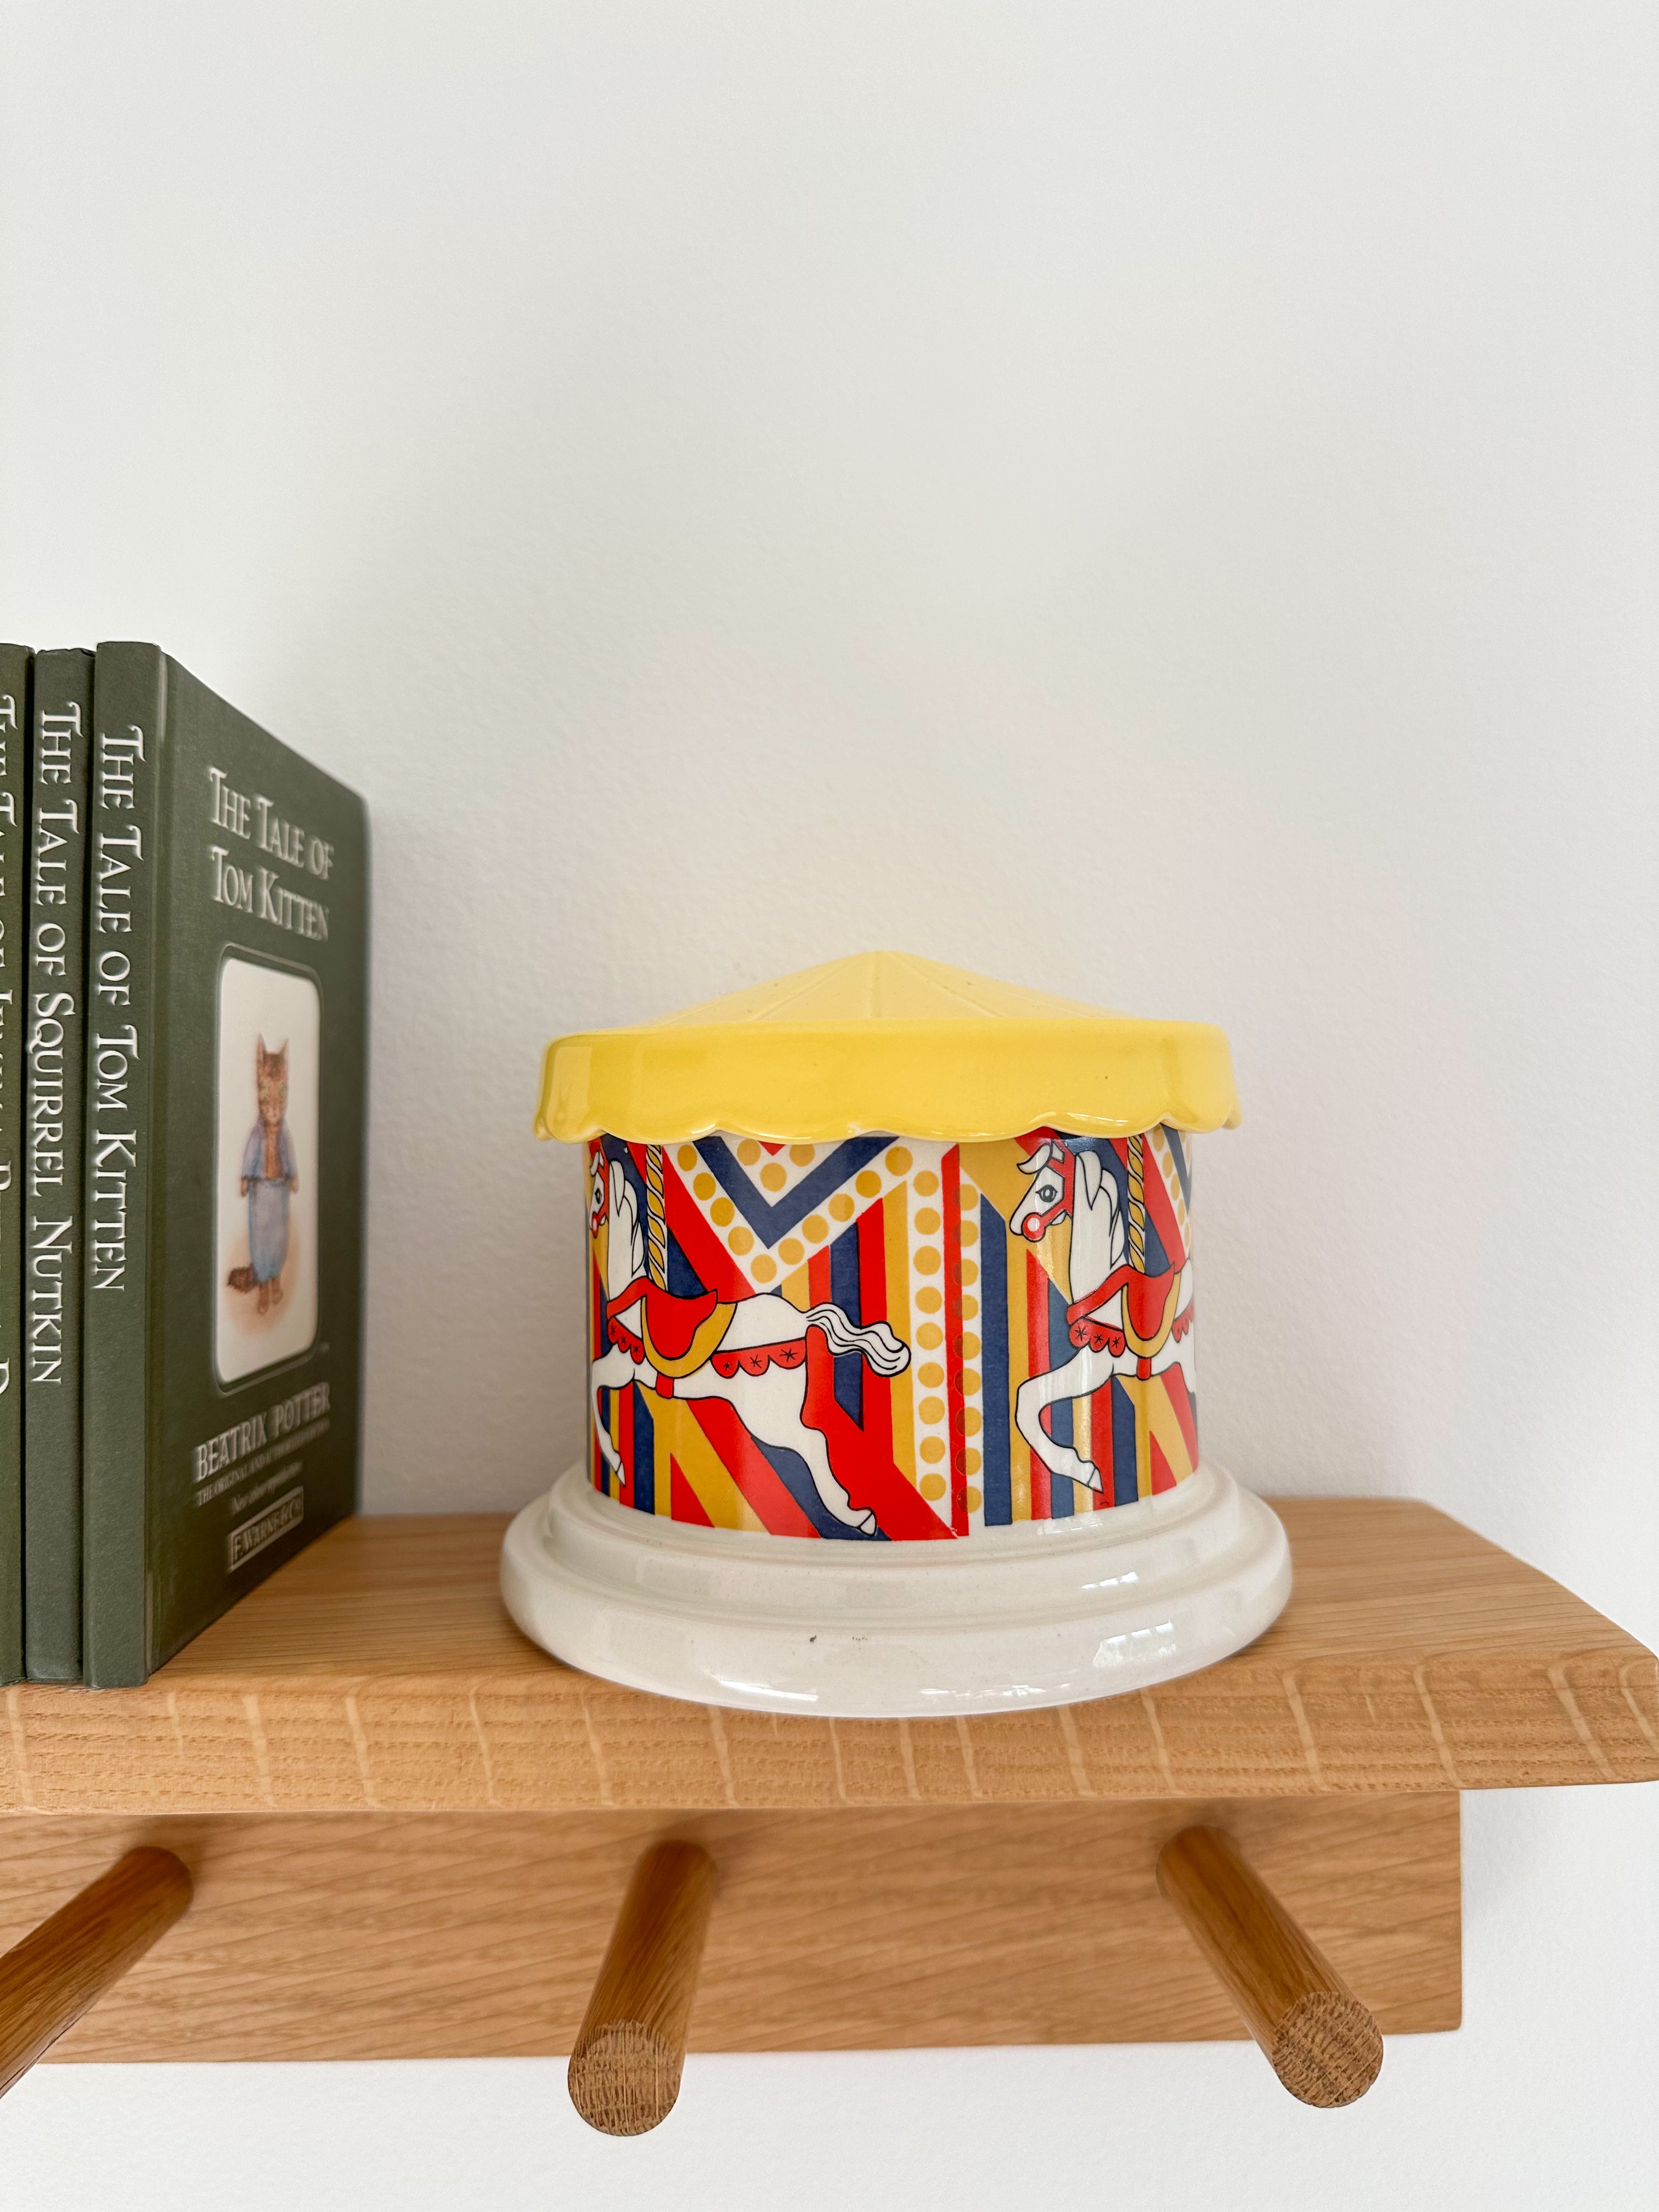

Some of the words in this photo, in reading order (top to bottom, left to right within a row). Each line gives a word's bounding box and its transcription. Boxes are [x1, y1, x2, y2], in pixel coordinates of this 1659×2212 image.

[42, 701, 83, 785] THE
[101, 725, 146, 810] THE
[36, 799, 79, 906] TALE
[209, 766, 251, 840] THE
[255, 795, 305, 868] TALE
[307, 836, 334, 881] OF
[99, 825, 144, 933] TALE
[210, 845, 254, 913] TOM
[255, 865, 330, 941] KITTEN
[36, 923, 66, 976] OF
[97, 951, 131, 1006] OF
[29, 992, 76, 1197] SQUIRREL
[95, 1024, 140, 1111] TOM
[91, 1129, 137, 1292] KITTEN
[31, 1215, 73, 1384] NUTKIN
[194, 1410, 268, 1483] BEATRIX
[269, 1381, 330, 1441] POTTER
